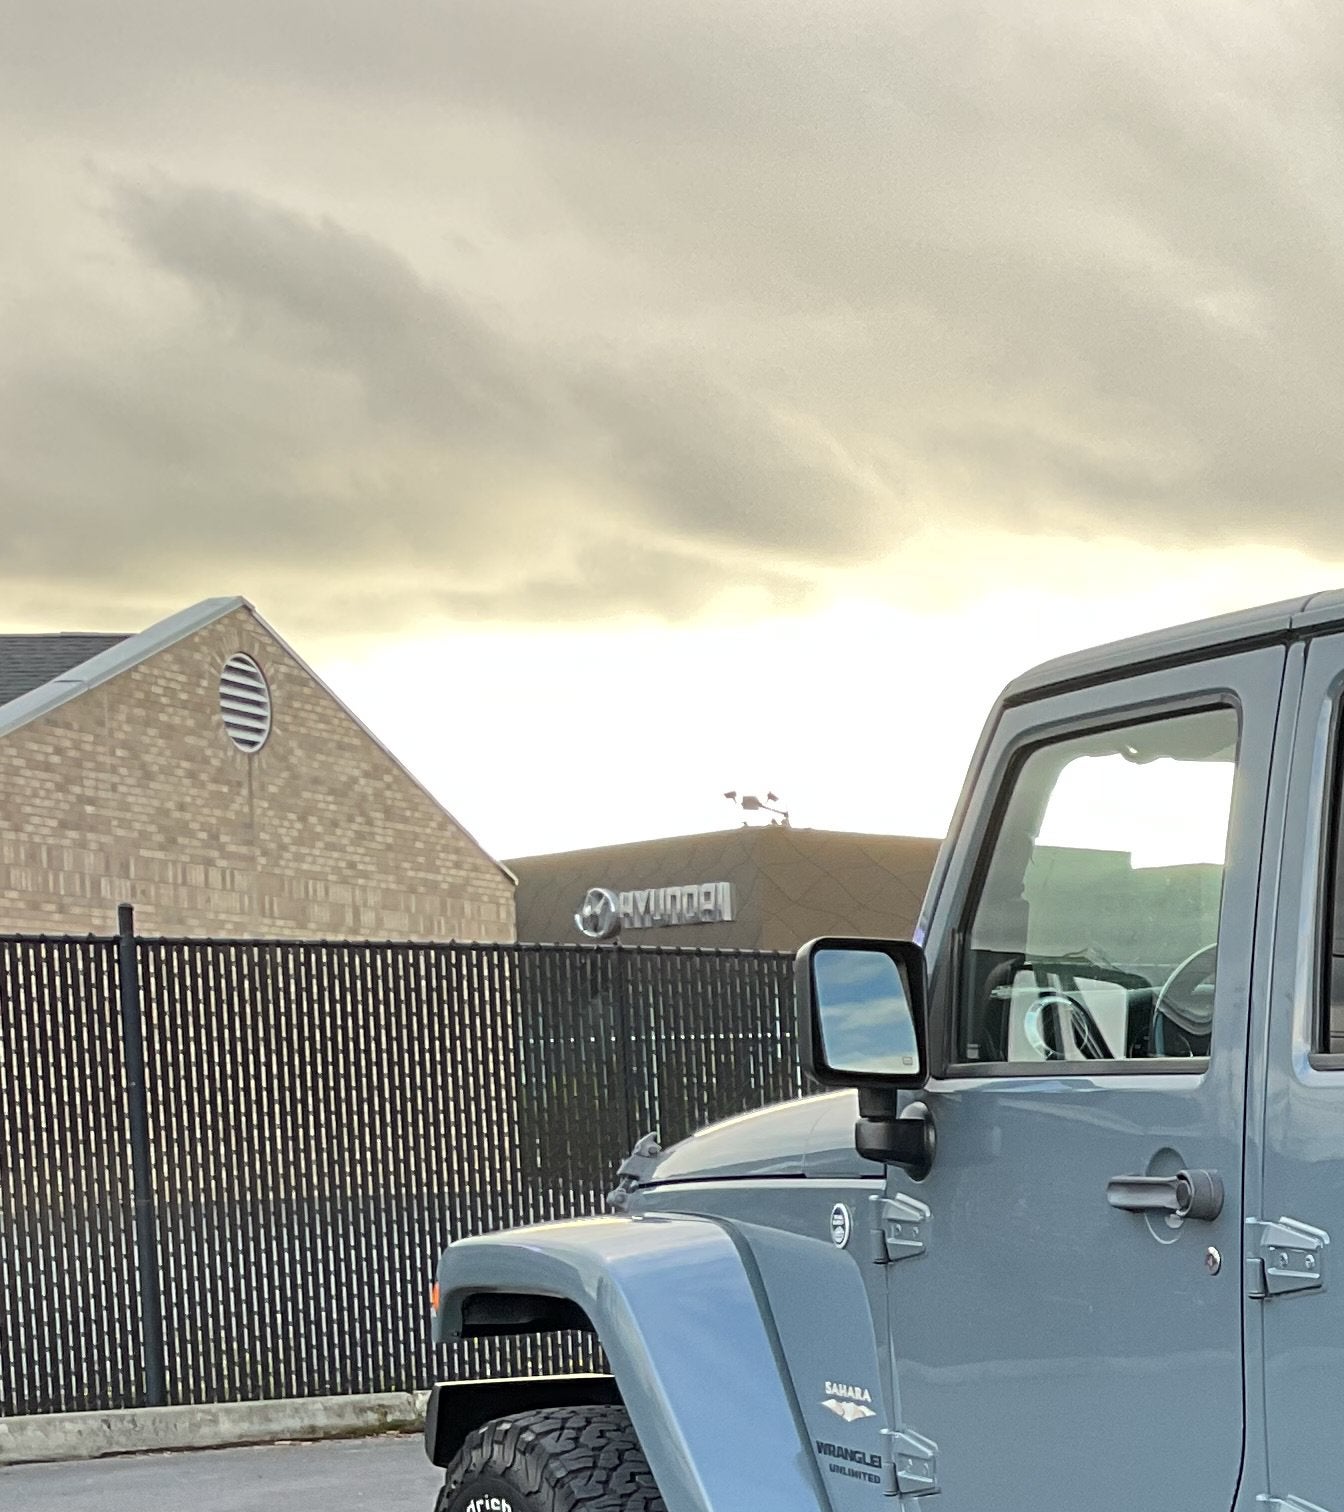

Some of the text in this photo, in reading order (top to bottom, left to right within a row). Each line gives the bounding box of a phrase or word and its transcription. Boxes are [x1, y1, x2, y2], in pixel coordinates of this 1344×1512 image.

[619, 881, 734, 928] HYUNDAI
[825, 1381, 872, 1403] SAHARA
[829, 1463, 881, 1484] UNLIMITED
